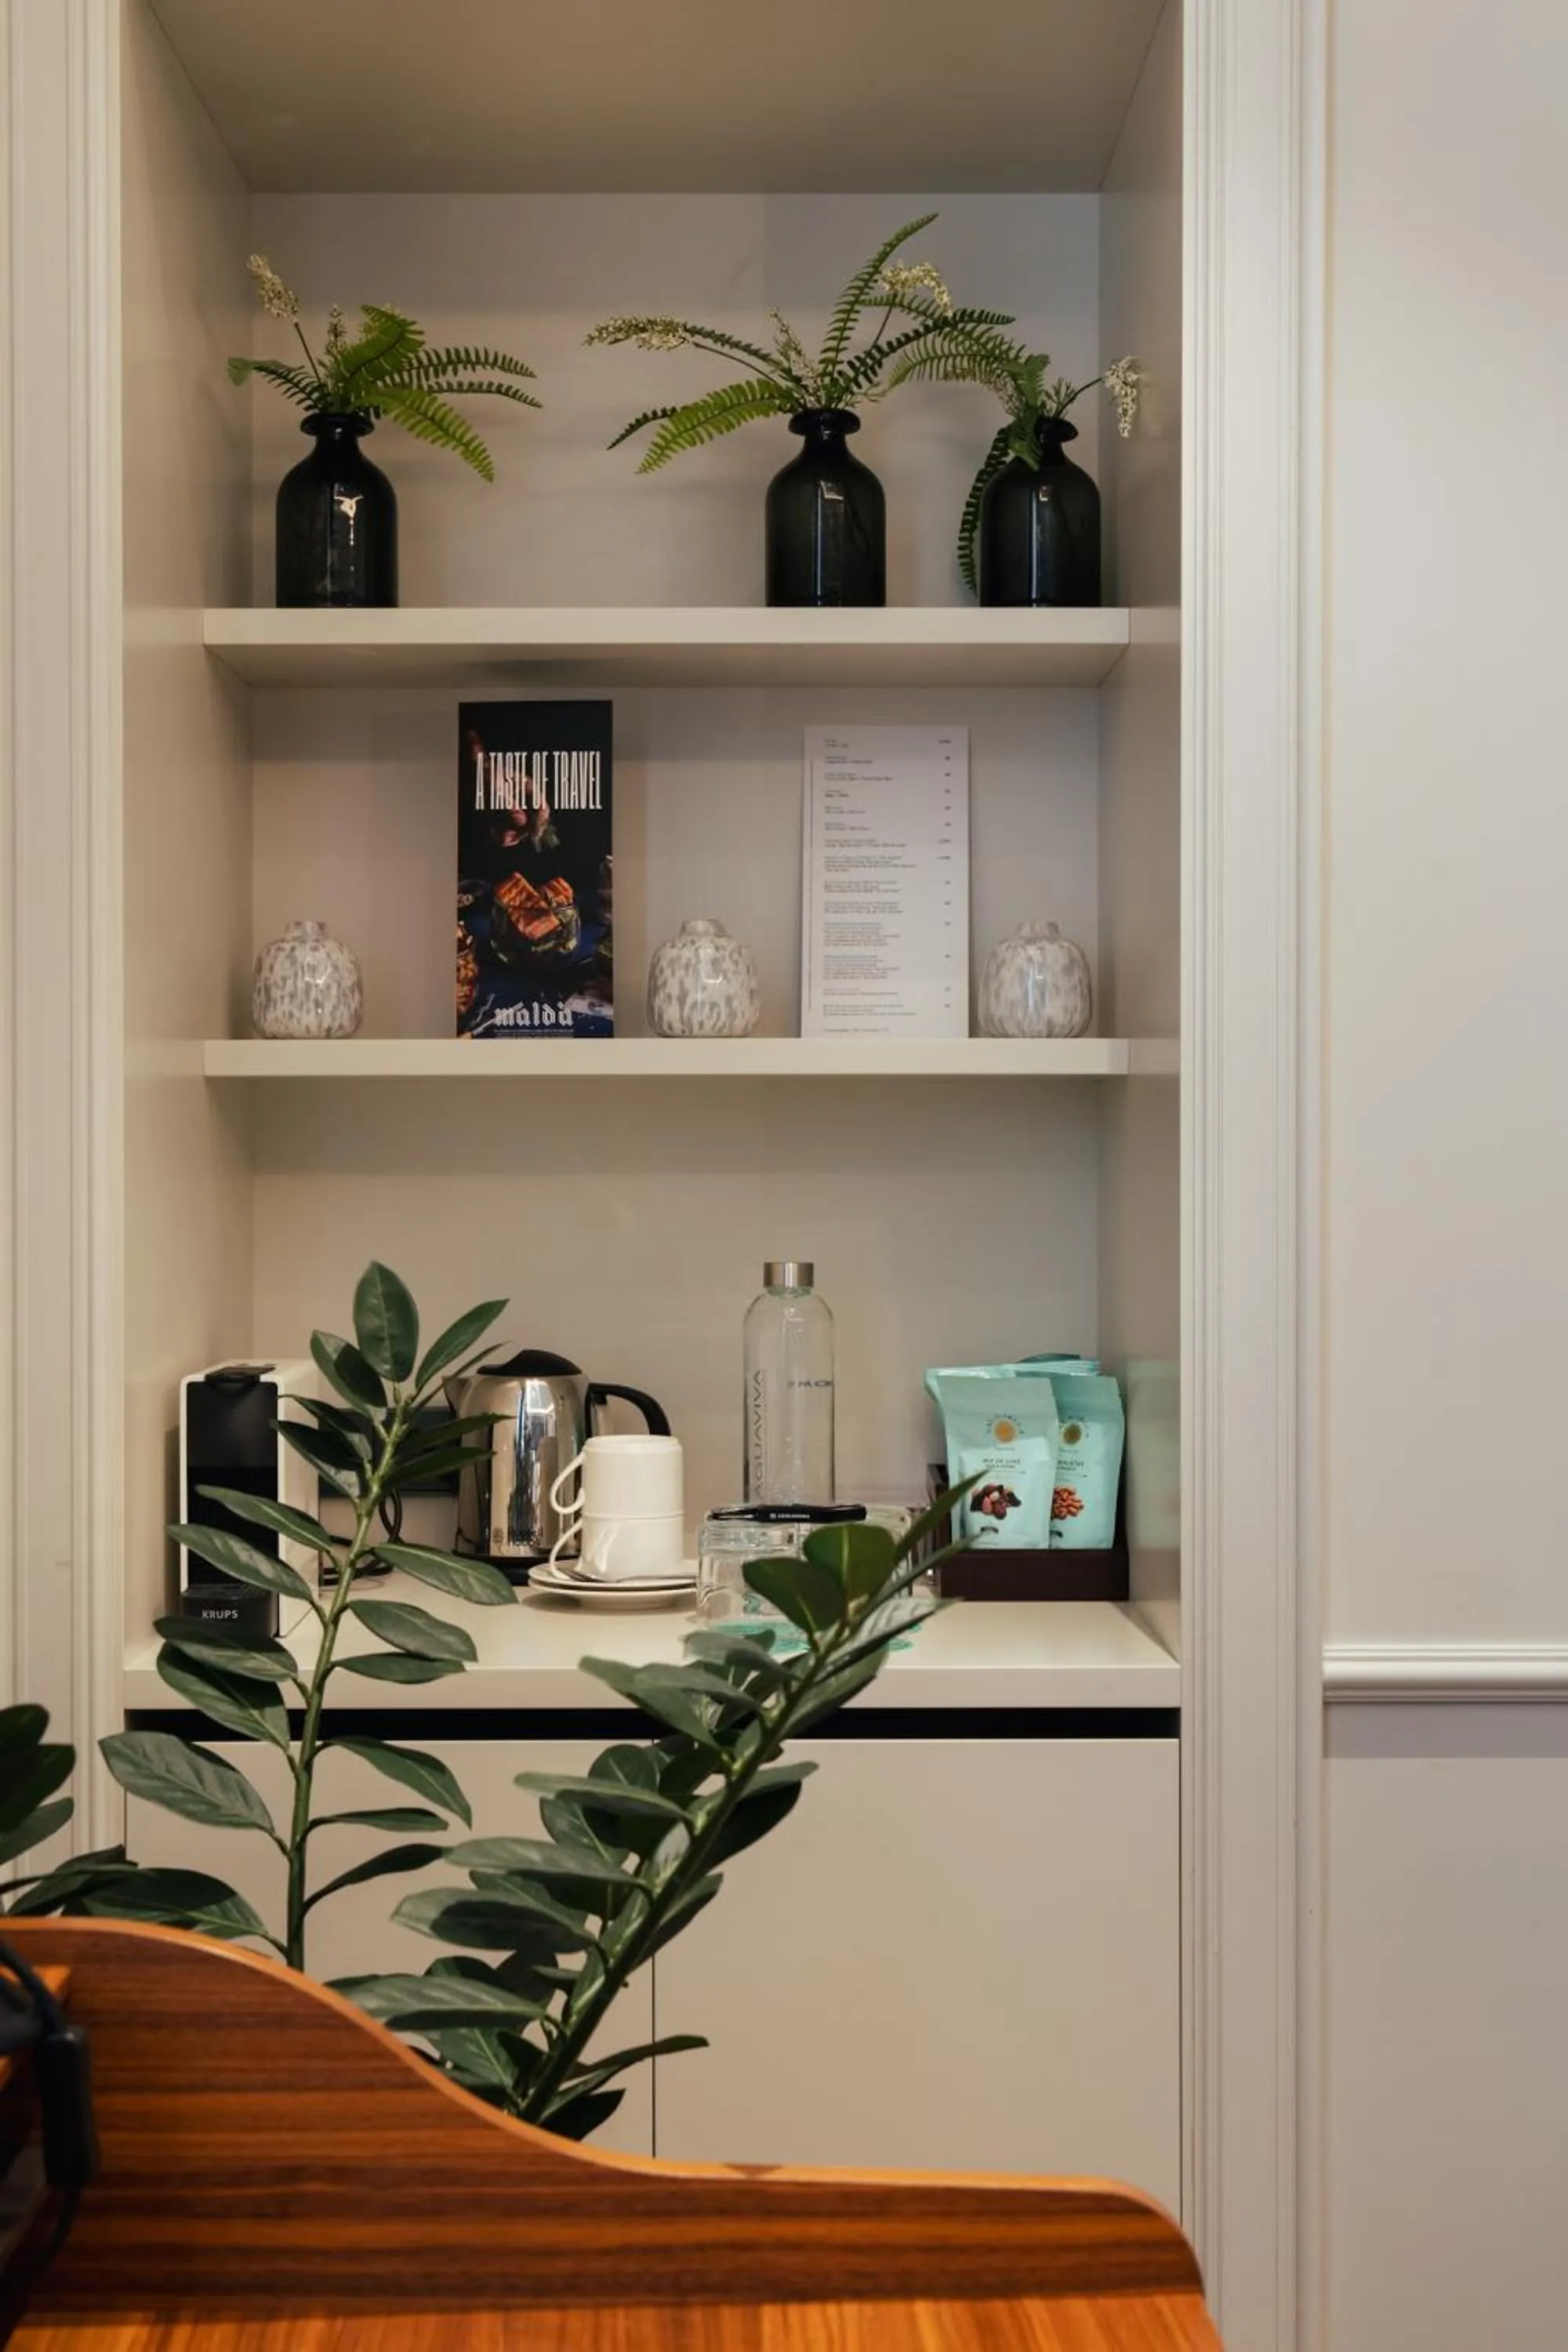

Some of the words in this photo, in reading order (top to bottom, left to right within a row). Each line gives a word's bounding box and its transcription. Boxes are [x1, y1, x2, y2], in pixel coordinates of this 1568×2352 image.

[476, 752, 485, 810] A
[489, 751, 528, 810] TASTE
[532, 751, 549, 810] OF
[553, 750, 602, 810] TRAVEL
[201, 1609, 239, 1619] KRUPS
